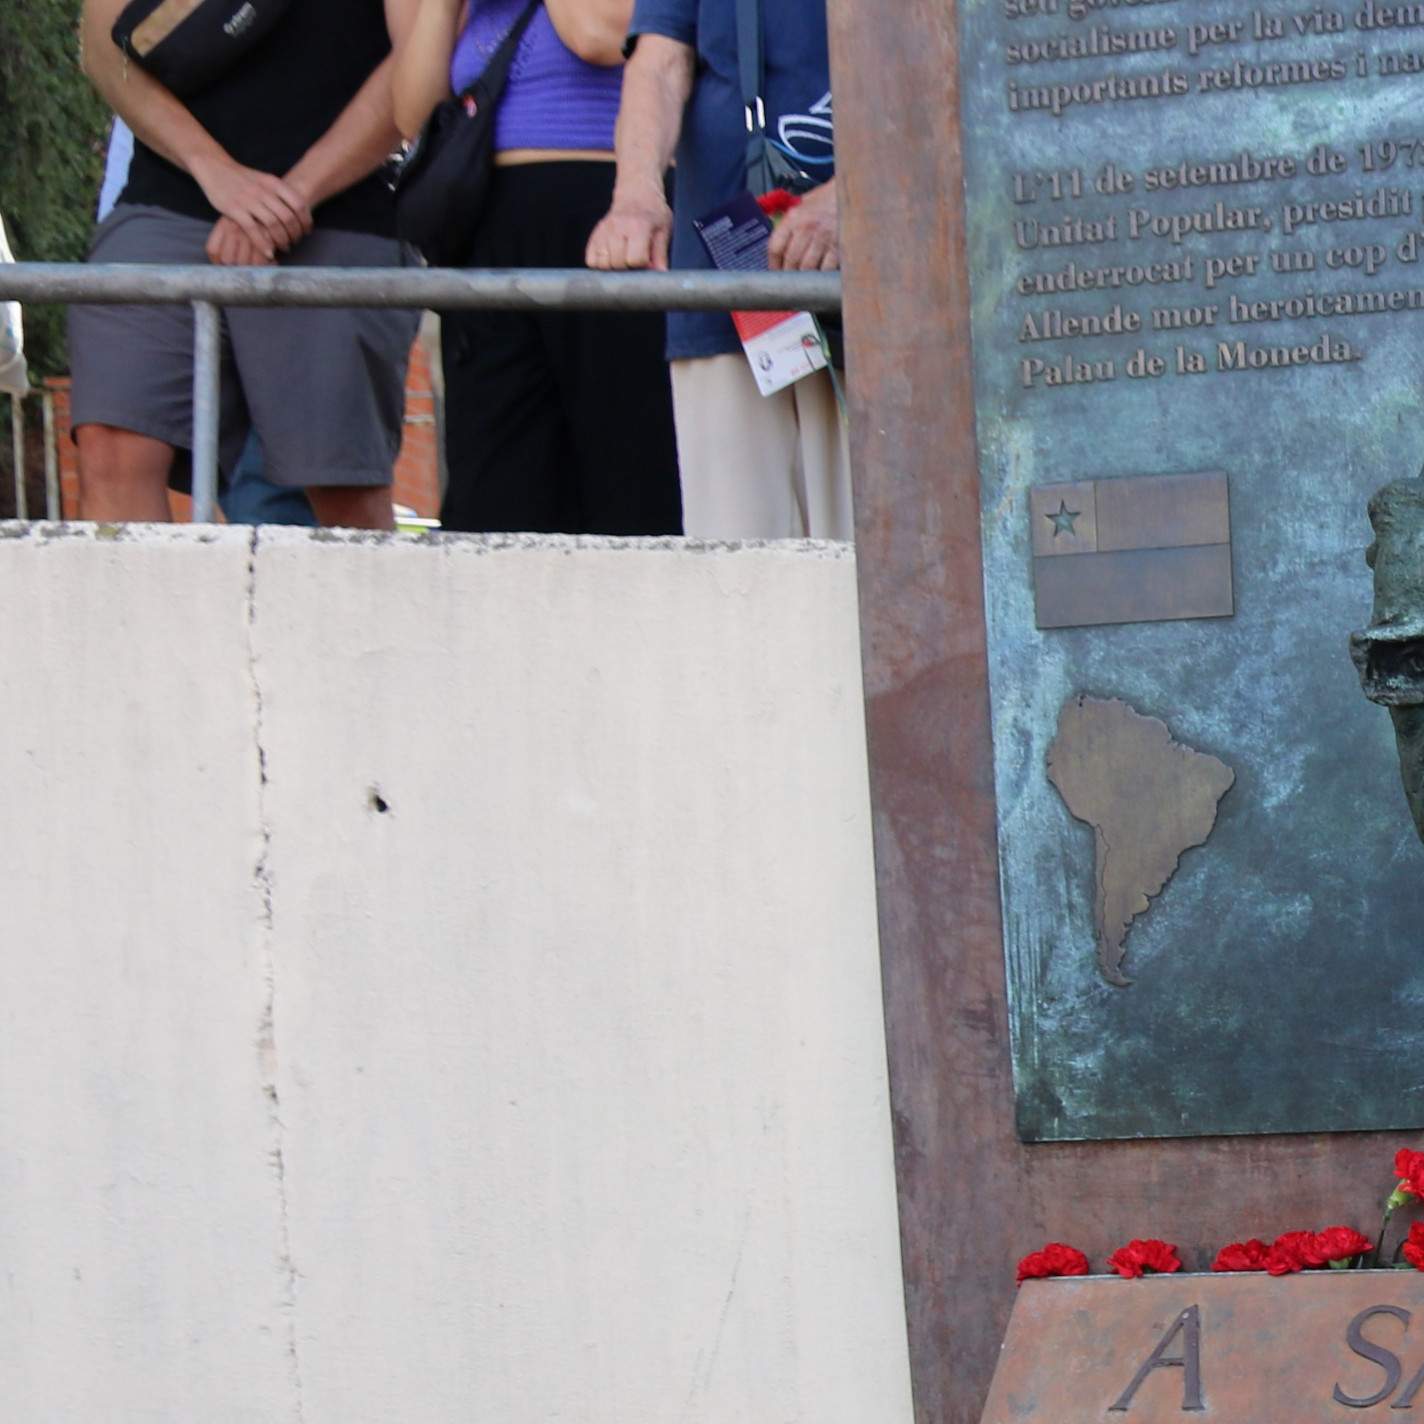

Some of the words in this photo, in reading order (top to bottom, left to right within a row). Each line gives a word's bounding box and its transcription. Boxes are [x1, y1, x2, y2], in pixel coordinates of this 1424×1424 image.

[1006, 24, 1177, 64] socialisme
[1187, 20, 1243, 56] per
[1254, 8, 1284, 40] la
[1294, 7, 1345, 36] via
[1008, 70, 1189, 116] importants
[1198, 58, 1346, 91] reformes
[1354, 51, 1368, 77] i
[1096, 163, 1134, 195] de
[1144, 151, 1297, 192] setembre
[1306, 146, 1347, 176] de
[1012, 214, 1118, 250] Unitat
[1128, 201, 1272, 244] Popular,
[1282, 184, 1412, 235] presidit
[1016, 252, 1194, 296] enderrocat
[1204, 254, 1260, 289] per
[1271, 247, 1316, 274] un
[1325, 241, 1387, 276] cop
[1018, 305, 1142, 342] Allende
[1151, 301, 1219, 331] mor
[1020, 352, 1116, 389] Palau
[1125, 347, 1166, 379] de
[1175, 344, 1207, 375] la
[1216, 334, 1363, 372] Moneda.
[1107, 1304, 1207, 1413] A
